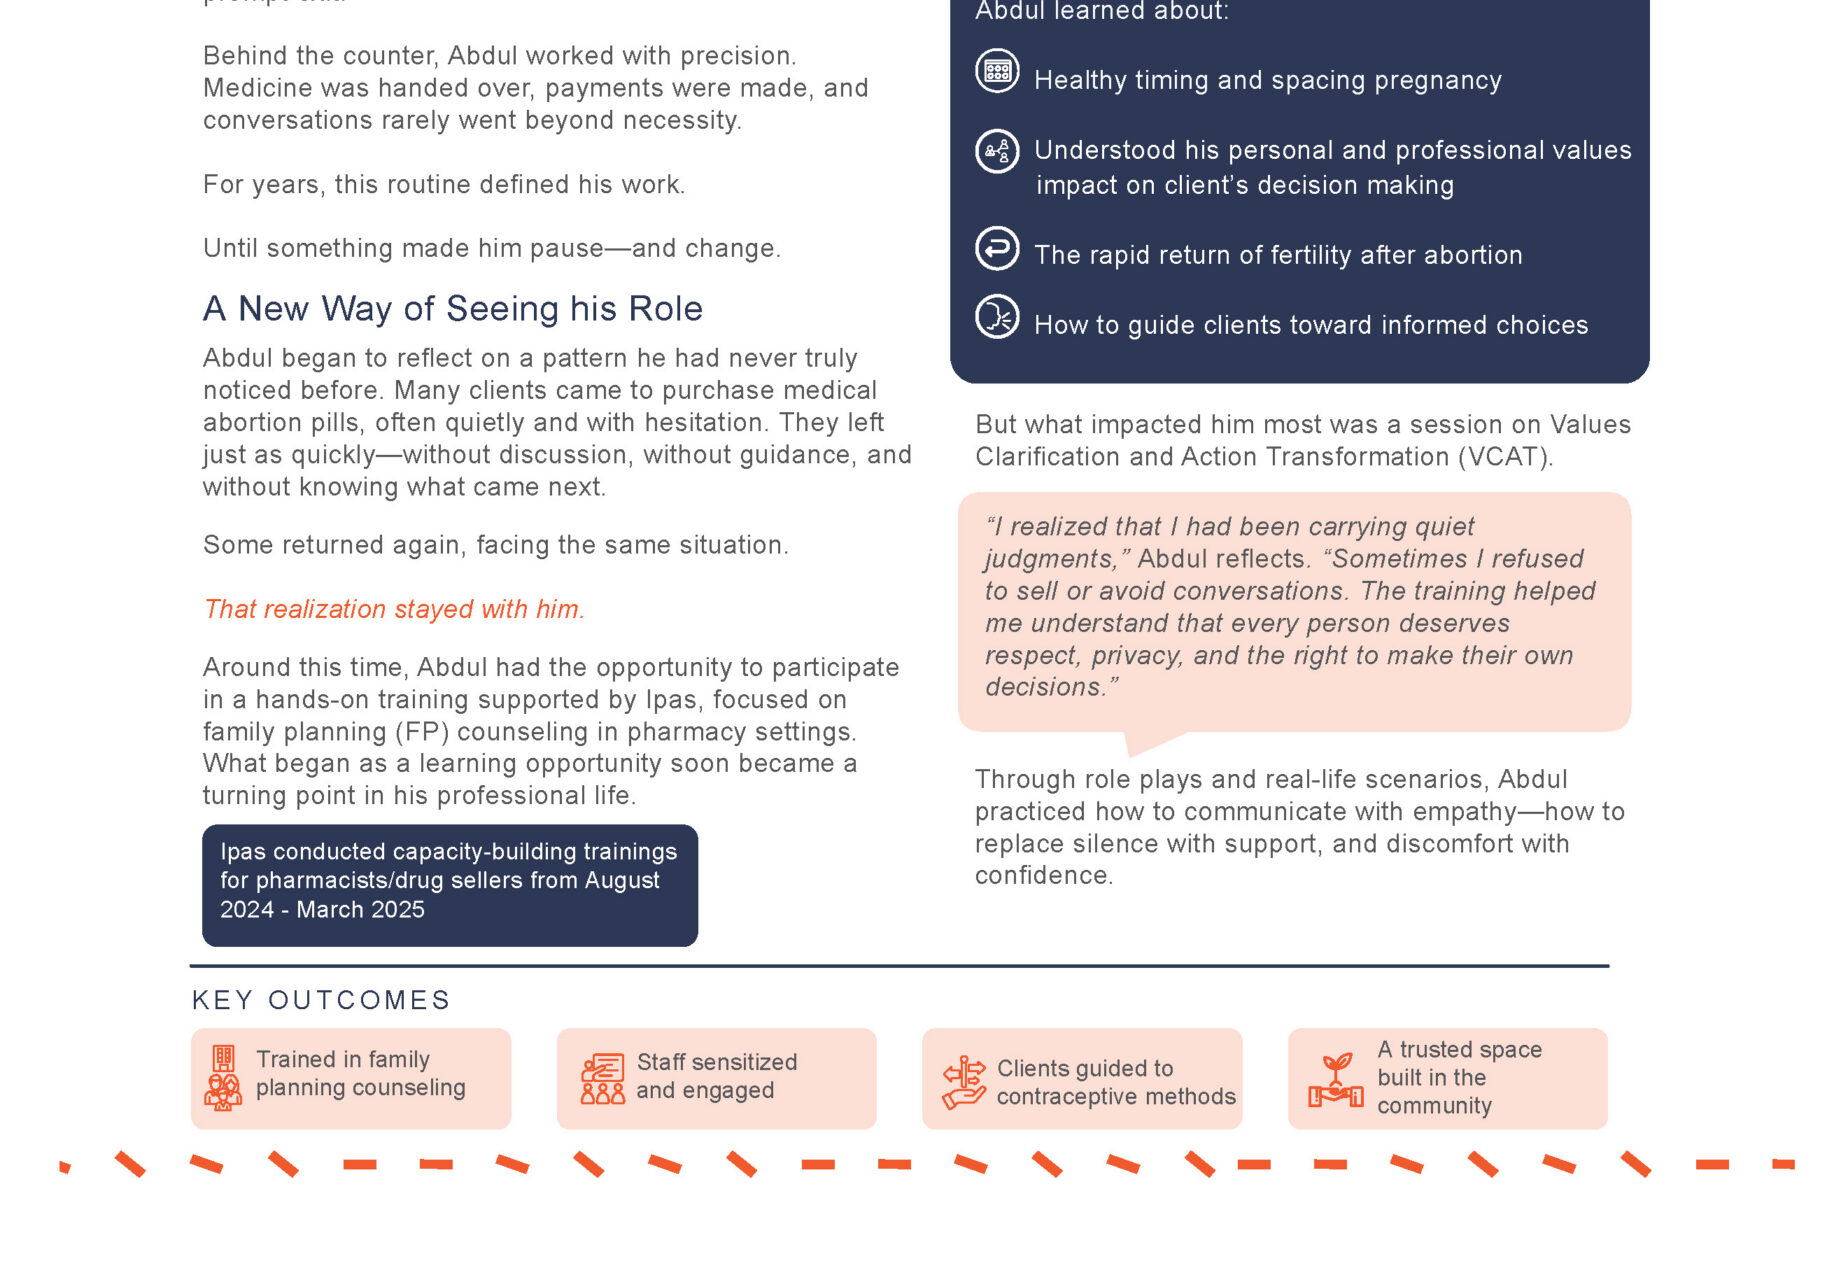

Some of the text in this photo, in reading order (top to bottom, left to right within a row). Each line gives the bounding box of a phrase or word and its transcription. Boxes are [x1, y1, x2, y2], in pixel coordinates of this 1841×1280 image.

[975, 0, 1228, 20] Abdul learned about:
[1035, 69, 1503, 95] Healthy timing and spacing pregnancy
[204, 237, 257, 258] Until
[267, 237, 392, 264] something
[403, 237, 469, 258] made
[479, 237, 522, 258] him
[685, 237, 781, 264] change.
[202, 293, 703, 329] A New Way of Seeing his Role
[976, 445, 1553, 472] Clarification and Action Transformation (VCAT).
[203, 533, 788, 560] Some returned again, facing the same situation.
[1137, 548, 1207, 569] Abdul
[1216, 547, 1311, 569] reflects.
[1476, 548, 1485, 569] I
[1491, 547, 1585, 569] refused
[205, 598, 584, 625] That realization stayed with him.
[221, 842, 678, 865] Ipas conducted capacity-building trainings
[220, 870, 660, 894] for pharmacists/drug sellers from August
[975, 864, 1113, 885] confidence.
[220, 900, 275, 919] 2024
[297, 900, 364, 919] March
[371, 900, 425, 919] 2025
[193, 989, 449, 1010] KEY OUTCOMES
[256, 1049, 431, 1073] Trained in family
[637, 1052, 798, 1071] Staff sensitized
[1377, 1039, 1543, 1064] A trusted space
[997, 1058, 1174, 1082] Clients guided to
[1378, 1067, 1487, 1087] built in the
[256, 1077, 466, 1101] planning counseling
[636, 1080, 774, 1104] and engaged
[997, 1086, 1237, 1110] contraceptive methods
[1377, 1095, 1493, 1119] community
